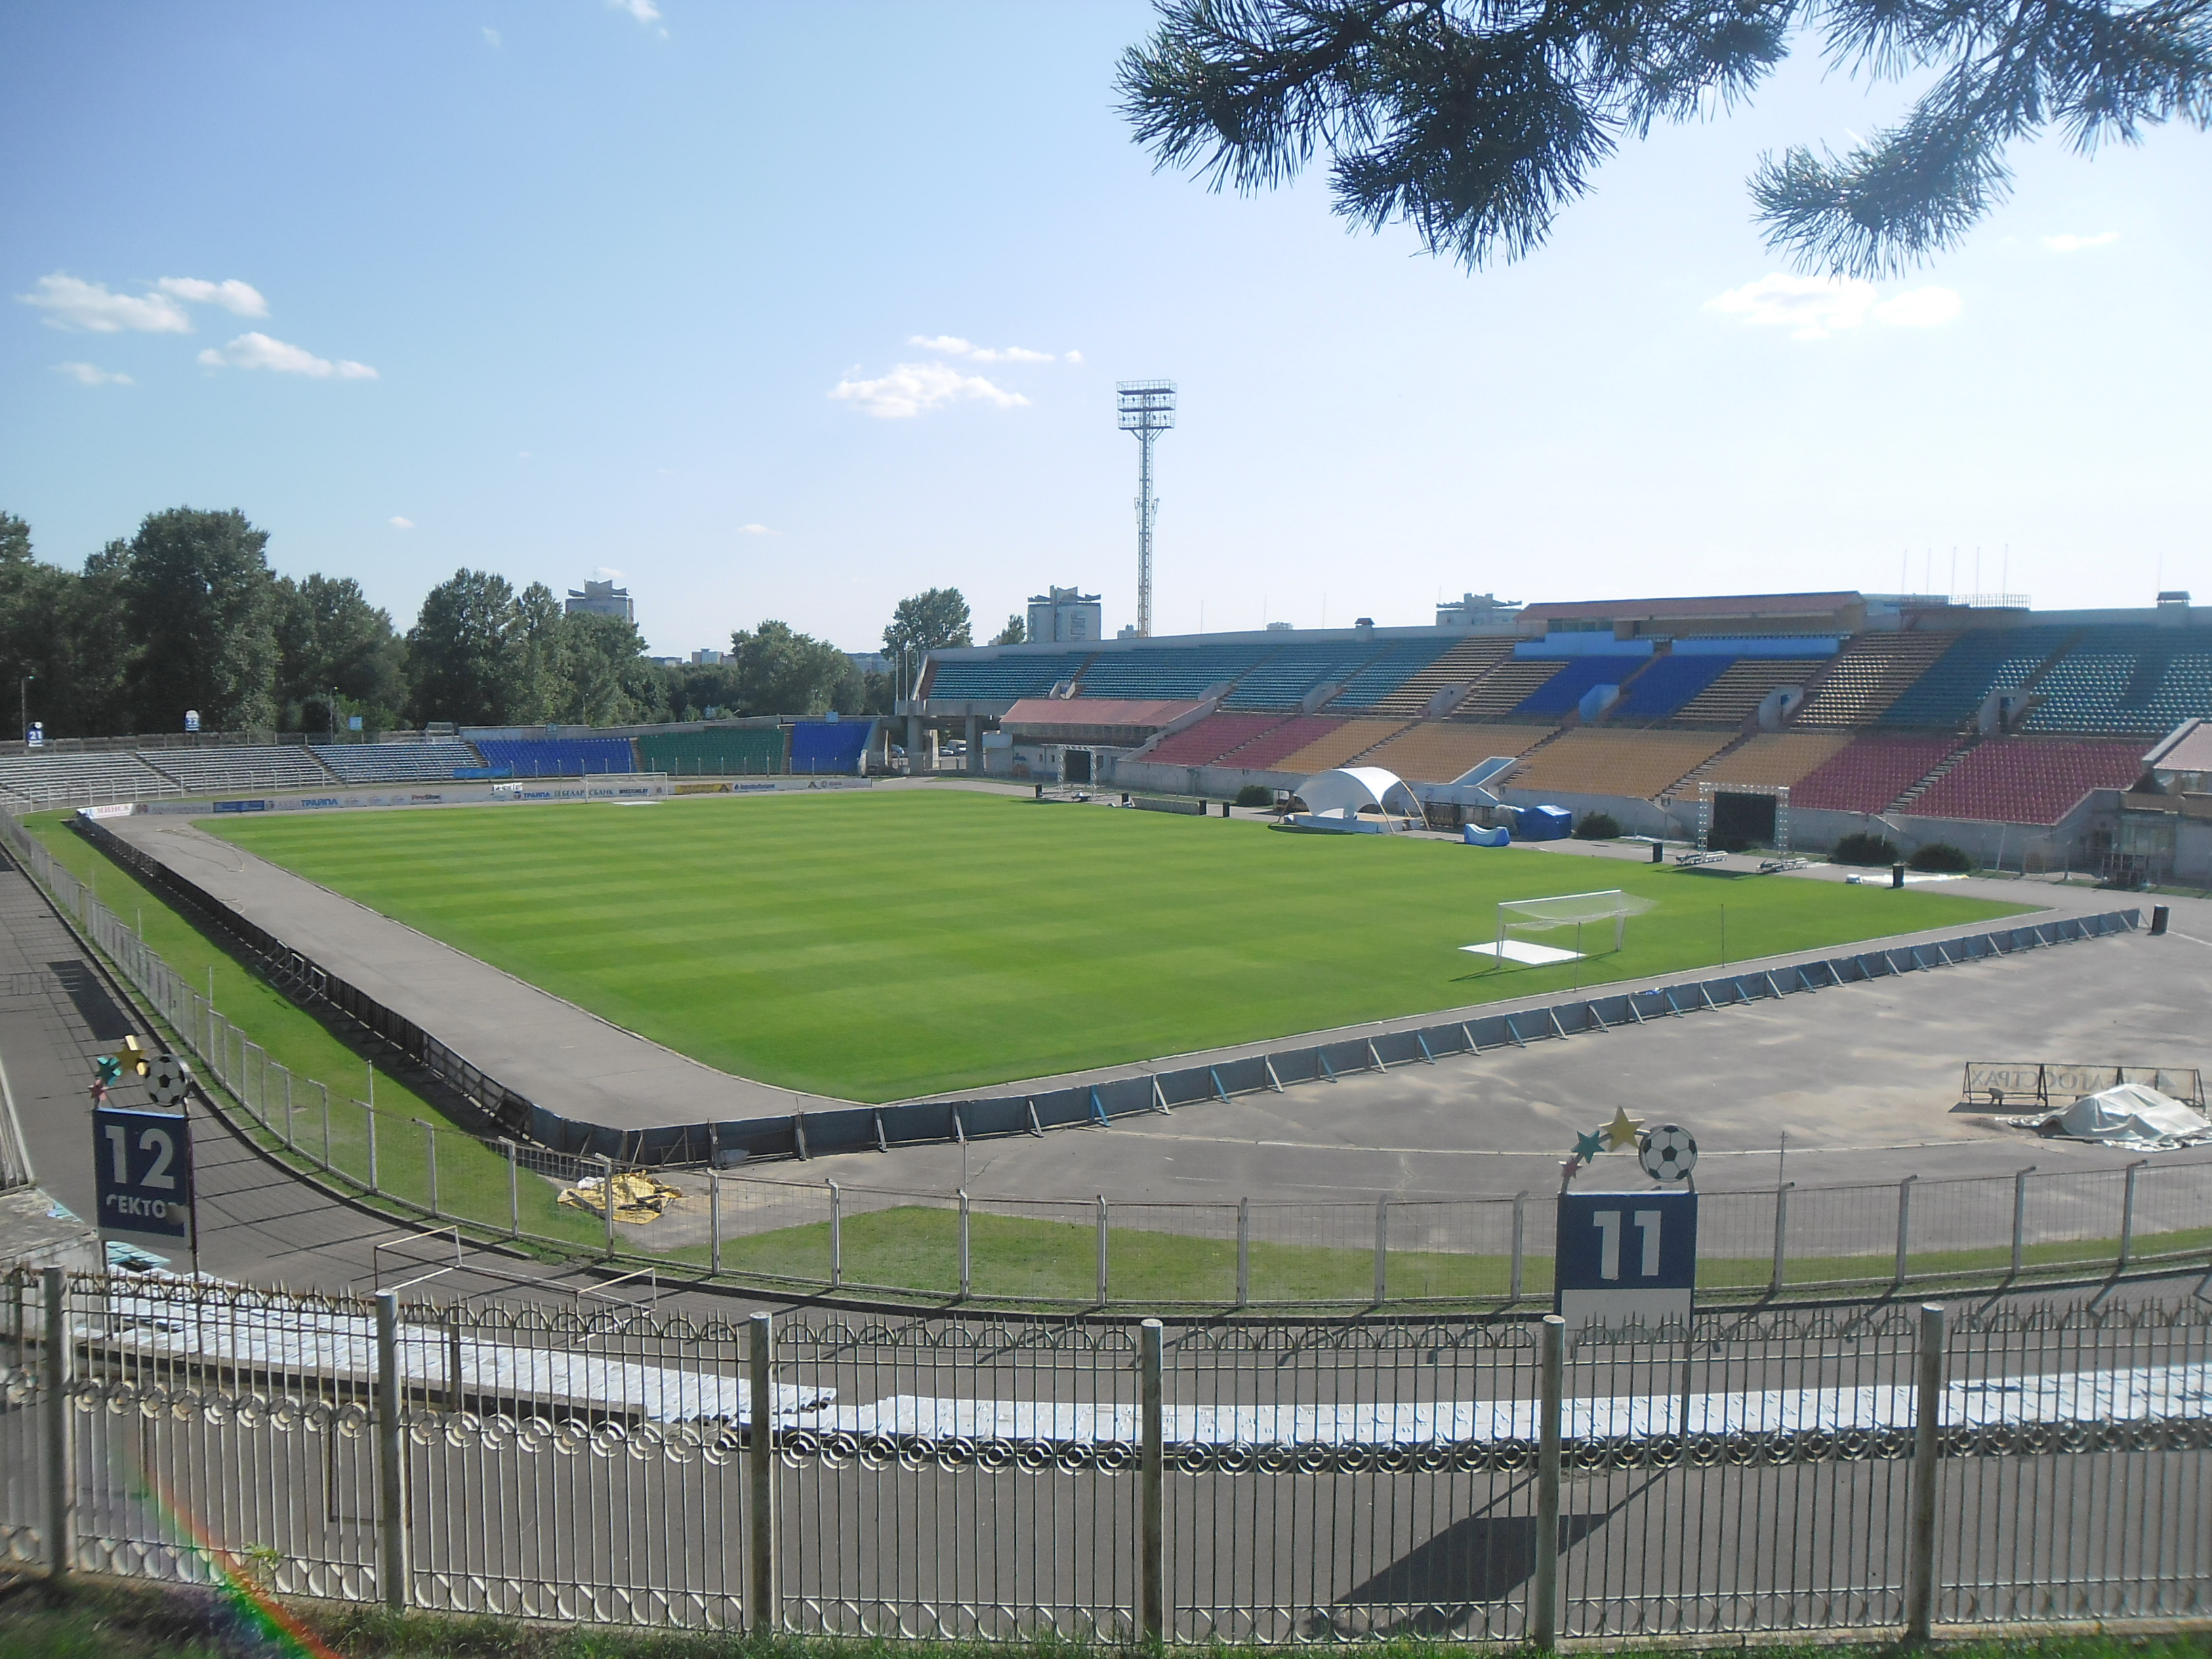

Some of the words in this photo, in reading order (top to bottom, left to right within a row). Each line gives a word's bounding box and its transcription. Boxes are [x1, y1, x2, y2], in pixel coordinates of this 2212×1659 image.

[29, 731, 41, 739] 21
[562, 789, 613, 797] БЕЛАРСБАНК
[97, 805, 129, 814] МИНСК
[105, 1125, 175, 1189] 12
[106, 1193, 178, 1219] СЕКТО
[1593, 1210, 1662, 1280] 11
